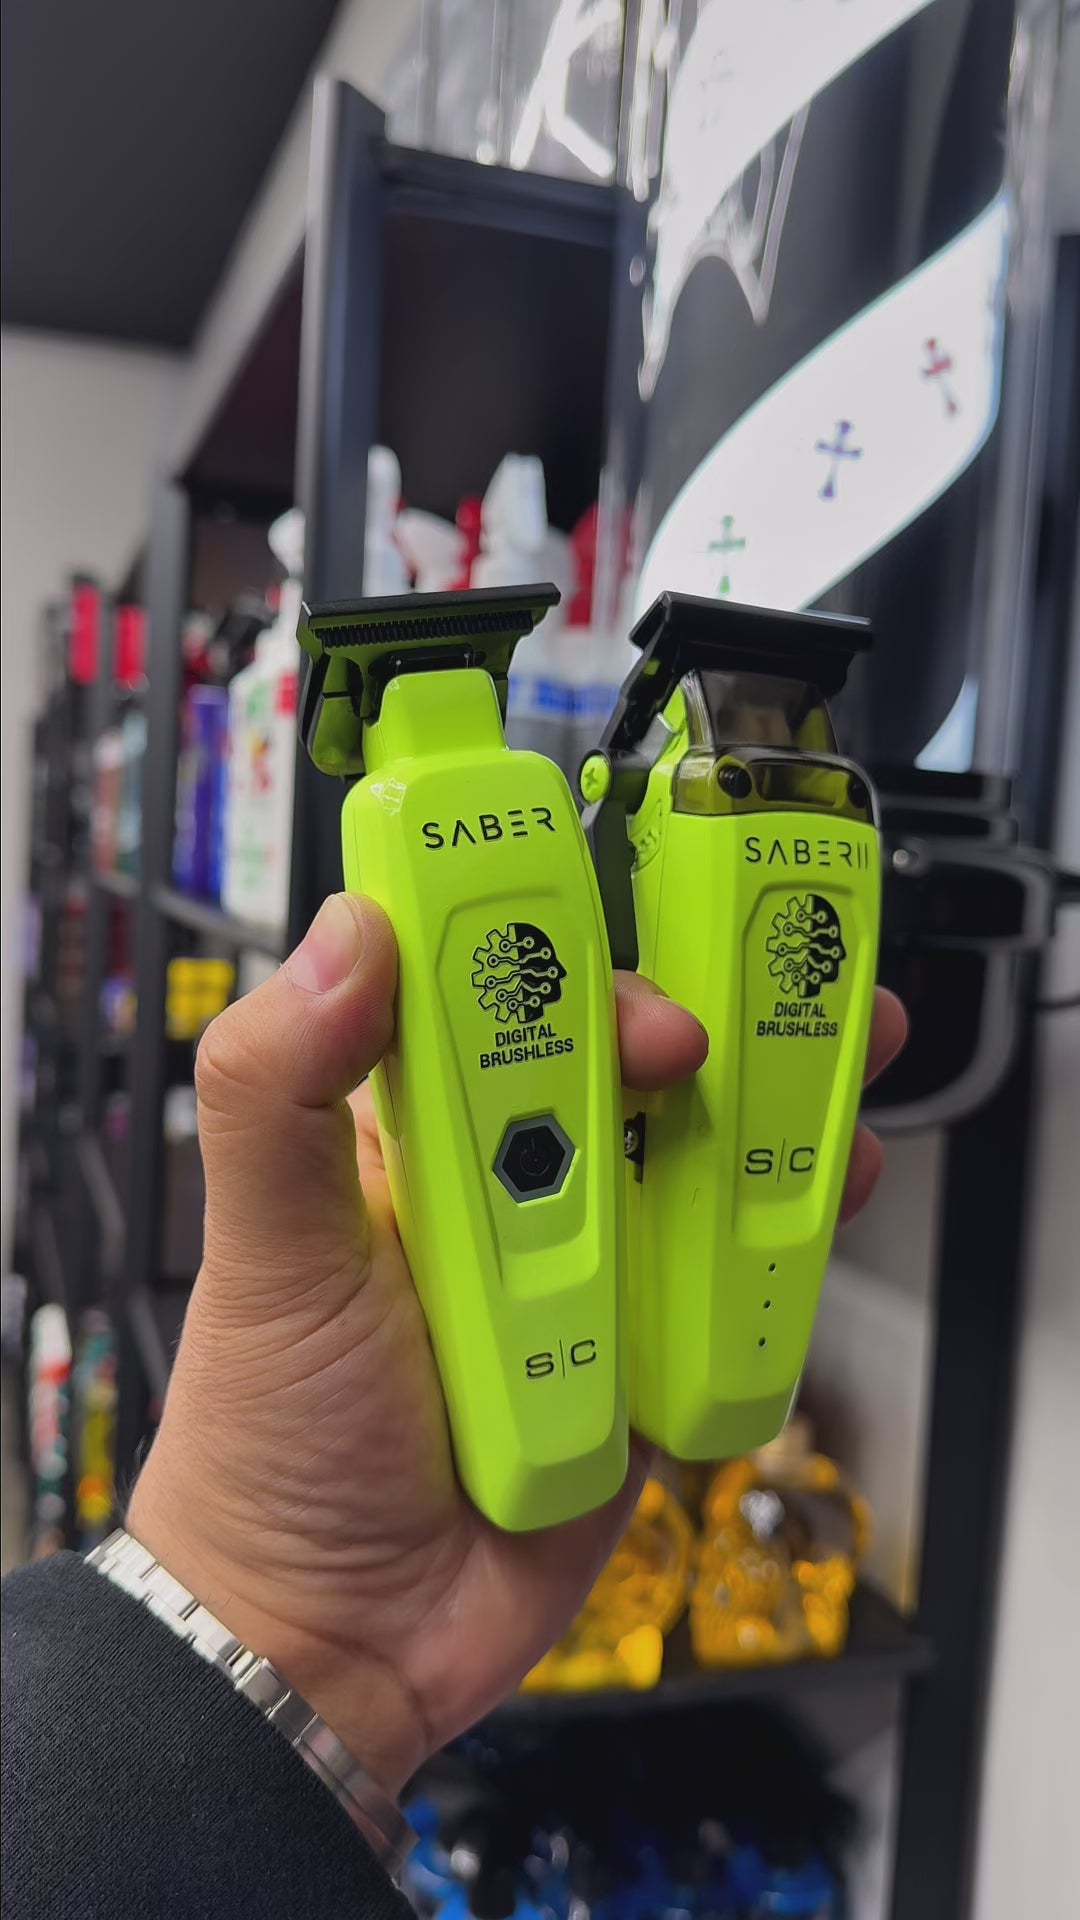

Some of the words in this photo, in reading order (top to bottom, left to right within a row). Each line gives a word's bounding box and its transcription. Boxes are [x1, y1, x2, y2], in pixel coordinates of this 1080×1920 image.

[422, 807, 555, 849] SABER
[774, 1001, 827, 1018] DIGITAL
[495, 1023, 557, 1048] DIGITAL
[756, 1021, 838, 1037] BRUSHLESS
[479, 1038, 575, 1069] BRUSHLESS
